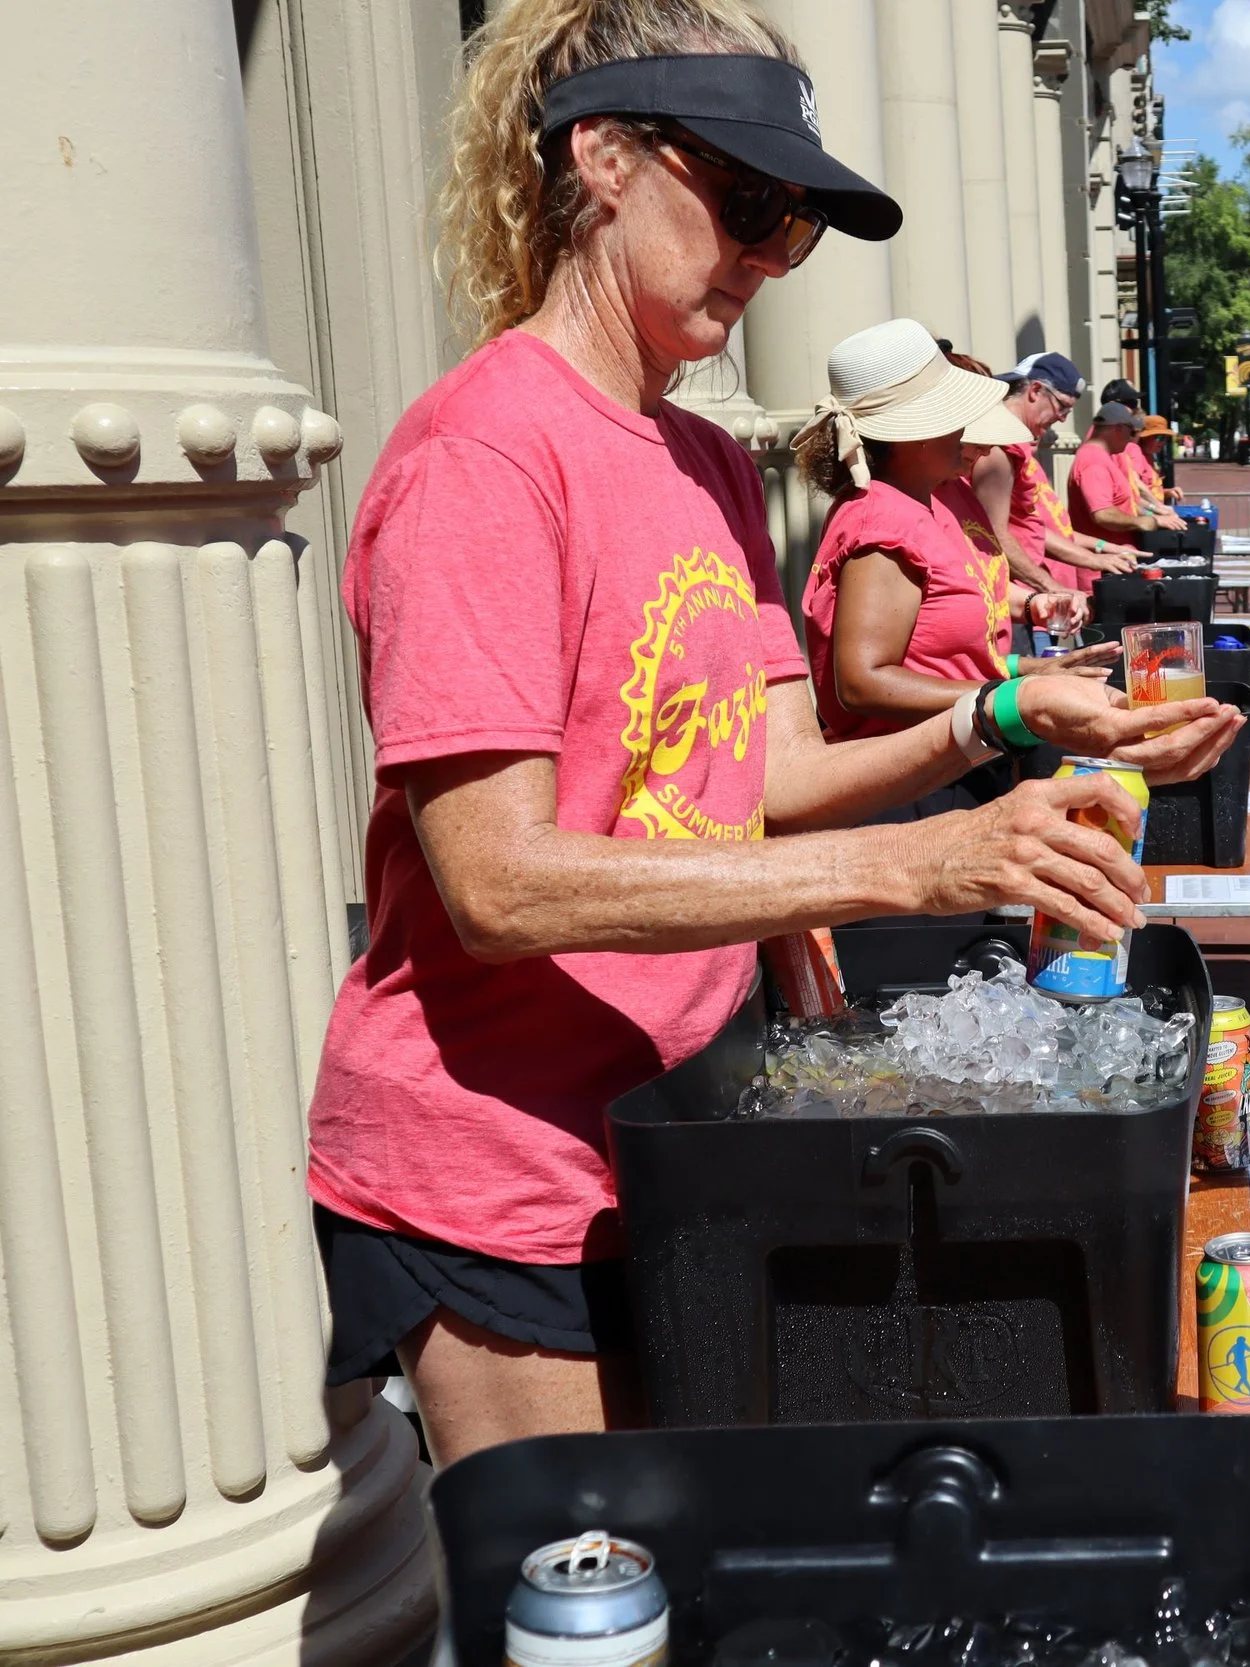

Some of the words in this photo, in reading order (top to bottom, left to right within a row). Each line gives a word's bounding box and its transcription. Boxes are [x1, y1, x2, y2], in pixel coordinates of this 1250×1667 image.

[650, 662, 766, 776] Fazie
[656, 783, 745, 840] SUMMER
[746, 799, 764, 840] BEE
